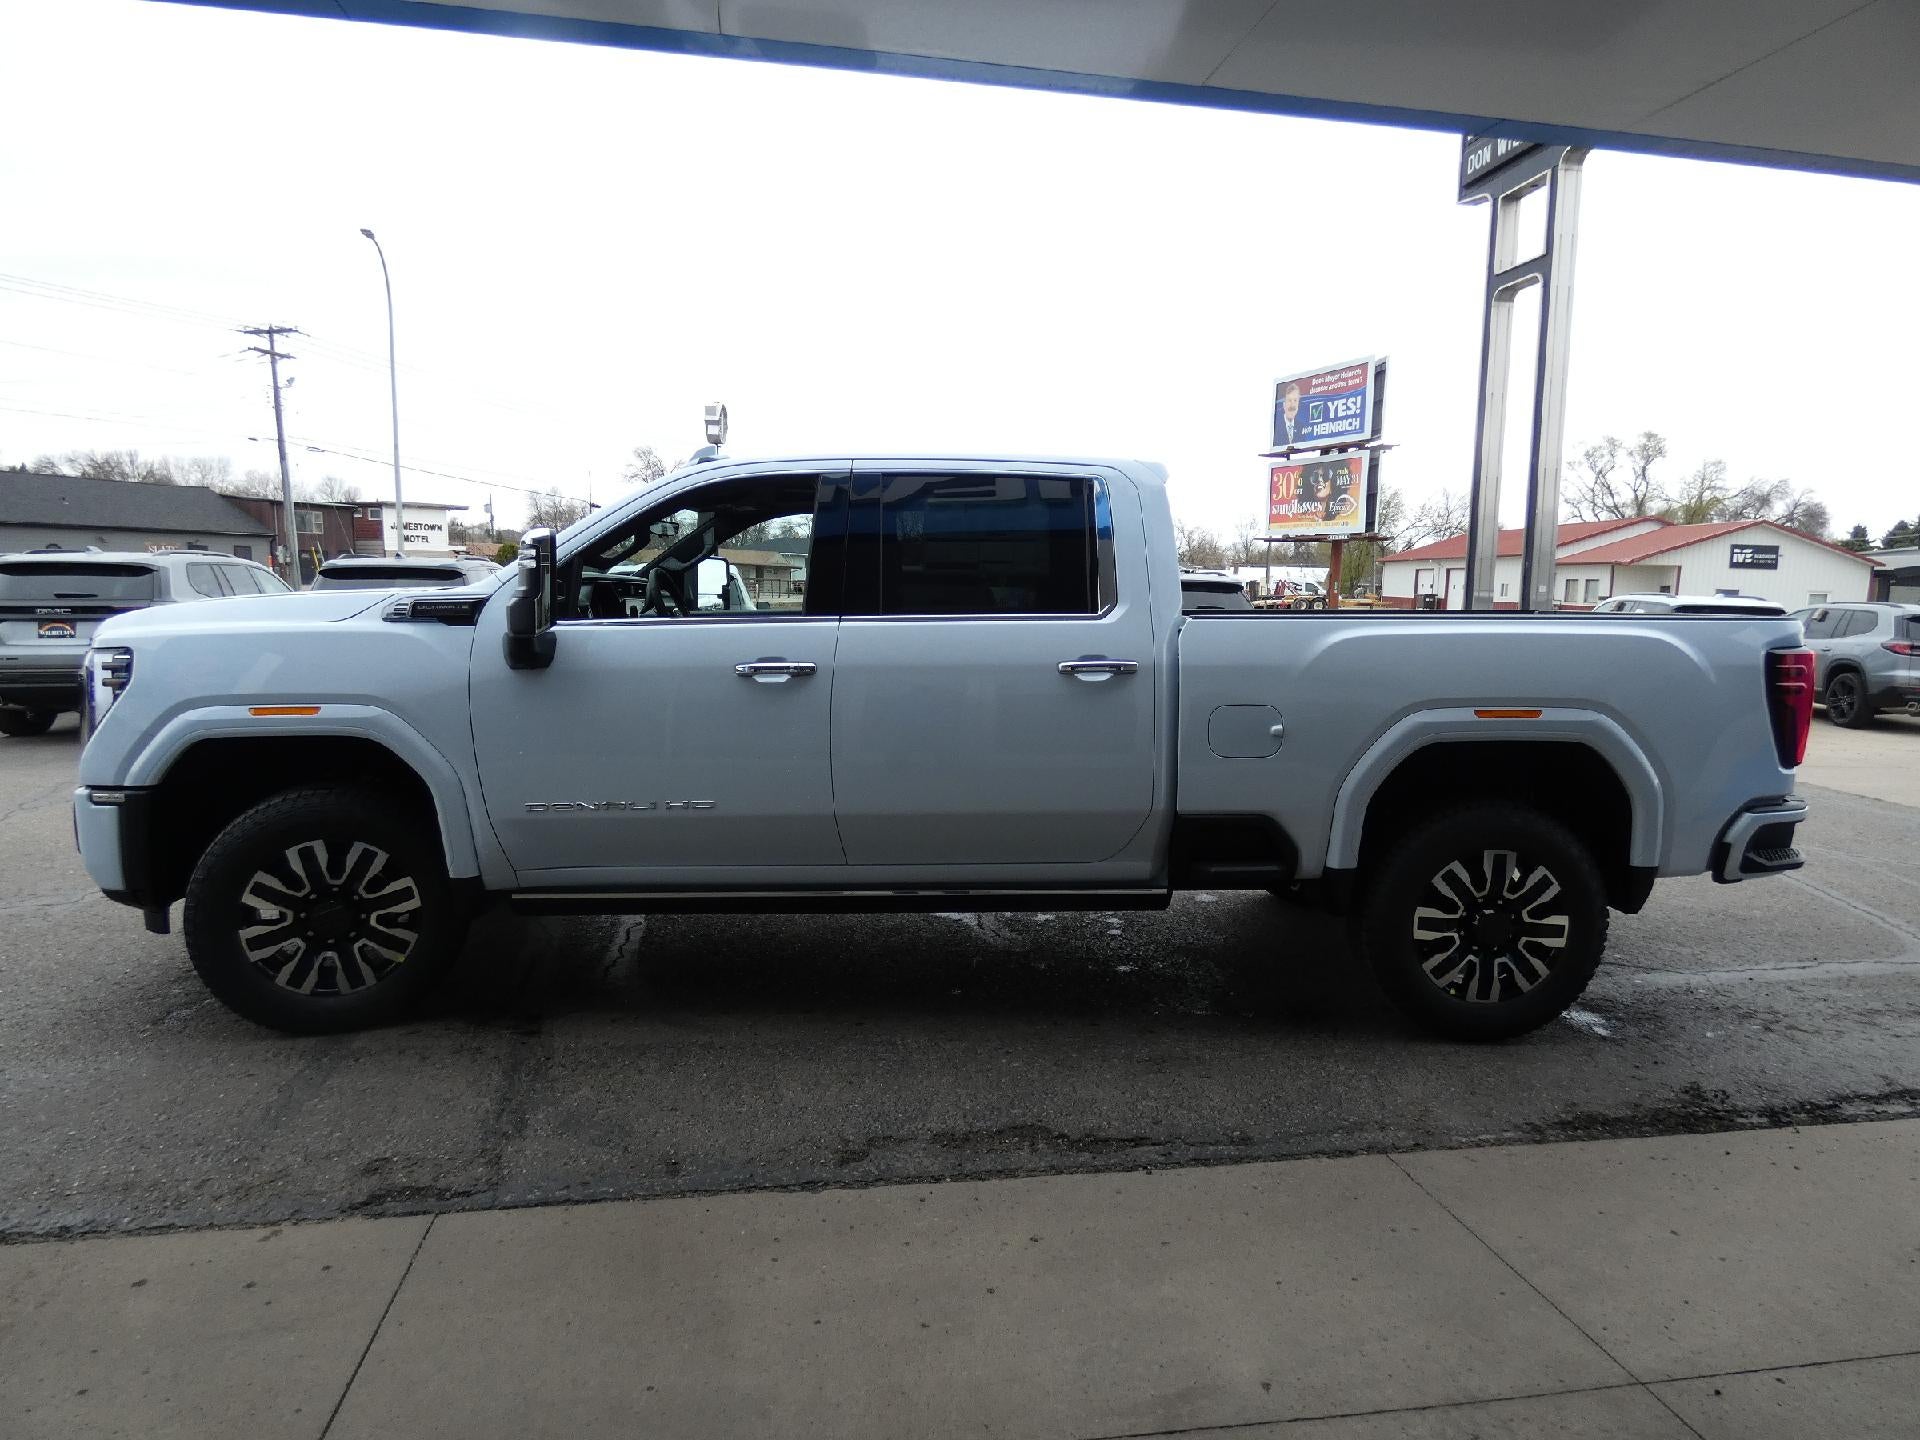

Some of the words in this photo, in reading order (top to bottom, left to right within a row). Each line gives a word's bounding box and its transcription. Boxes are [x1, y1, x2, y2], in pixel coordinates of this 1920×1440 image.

[1467, 144, 1491, 174] DON
[1327, 396, 1362, 419] YES!
[1313, 418, 1360, 436] HEINRICH
[1272, 499, 1323, 518] sunglasses
[390, 522, 442, 531] JMESTOWN
[403, 535, 430, 543] MOTEL
[523, 801, 657, 812] DENALI
[665, 800, 715, 809] HD
